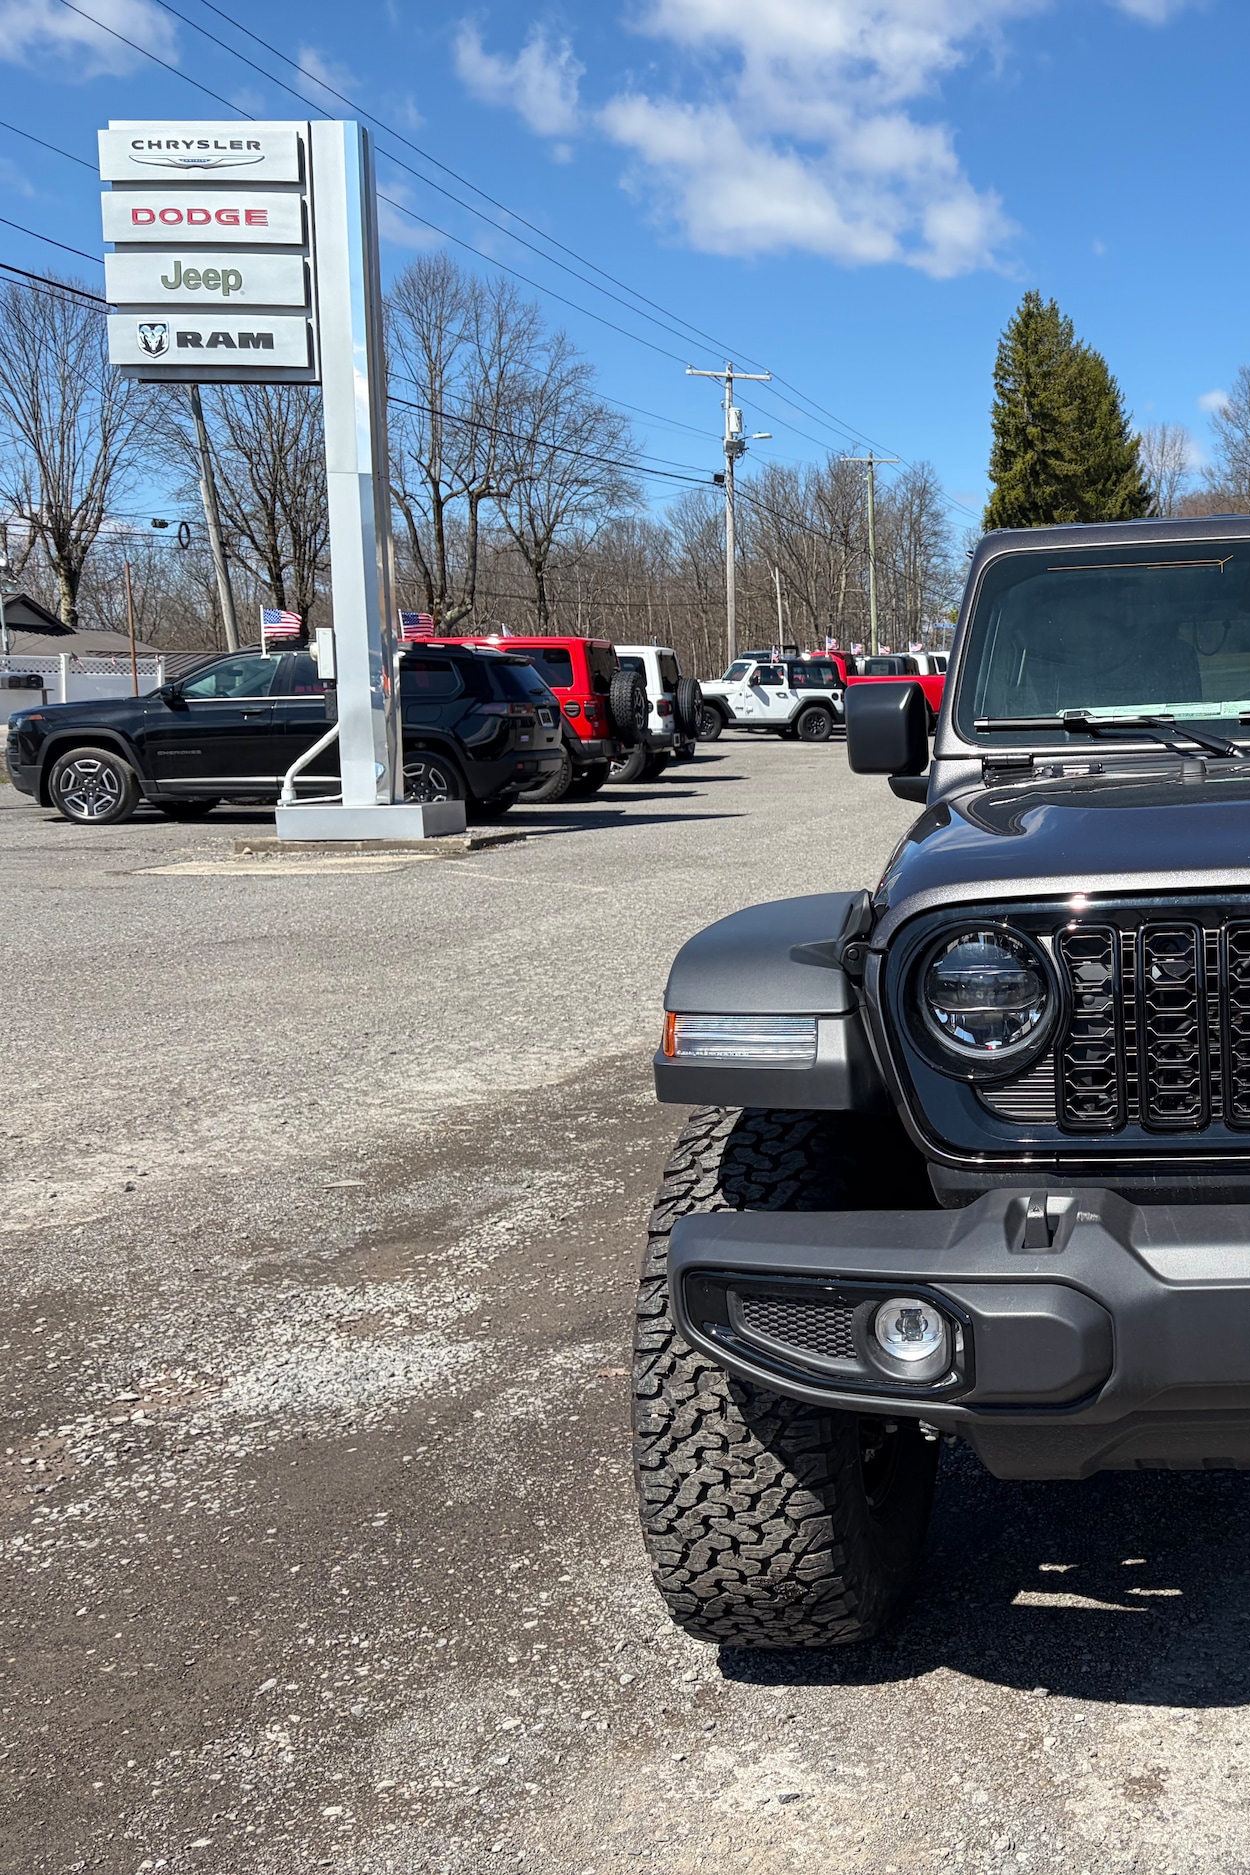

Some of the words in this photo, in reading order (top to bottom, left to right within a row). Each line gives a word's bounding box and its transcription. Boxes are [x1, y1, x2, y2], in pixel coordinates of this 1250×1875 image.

[131, 139, 261, 151] CHRYSLER
[131, 208, 269, 226] DODGE
[160, 260, 243, 296] Jeep
[176, 331, 275, 350] RAM
